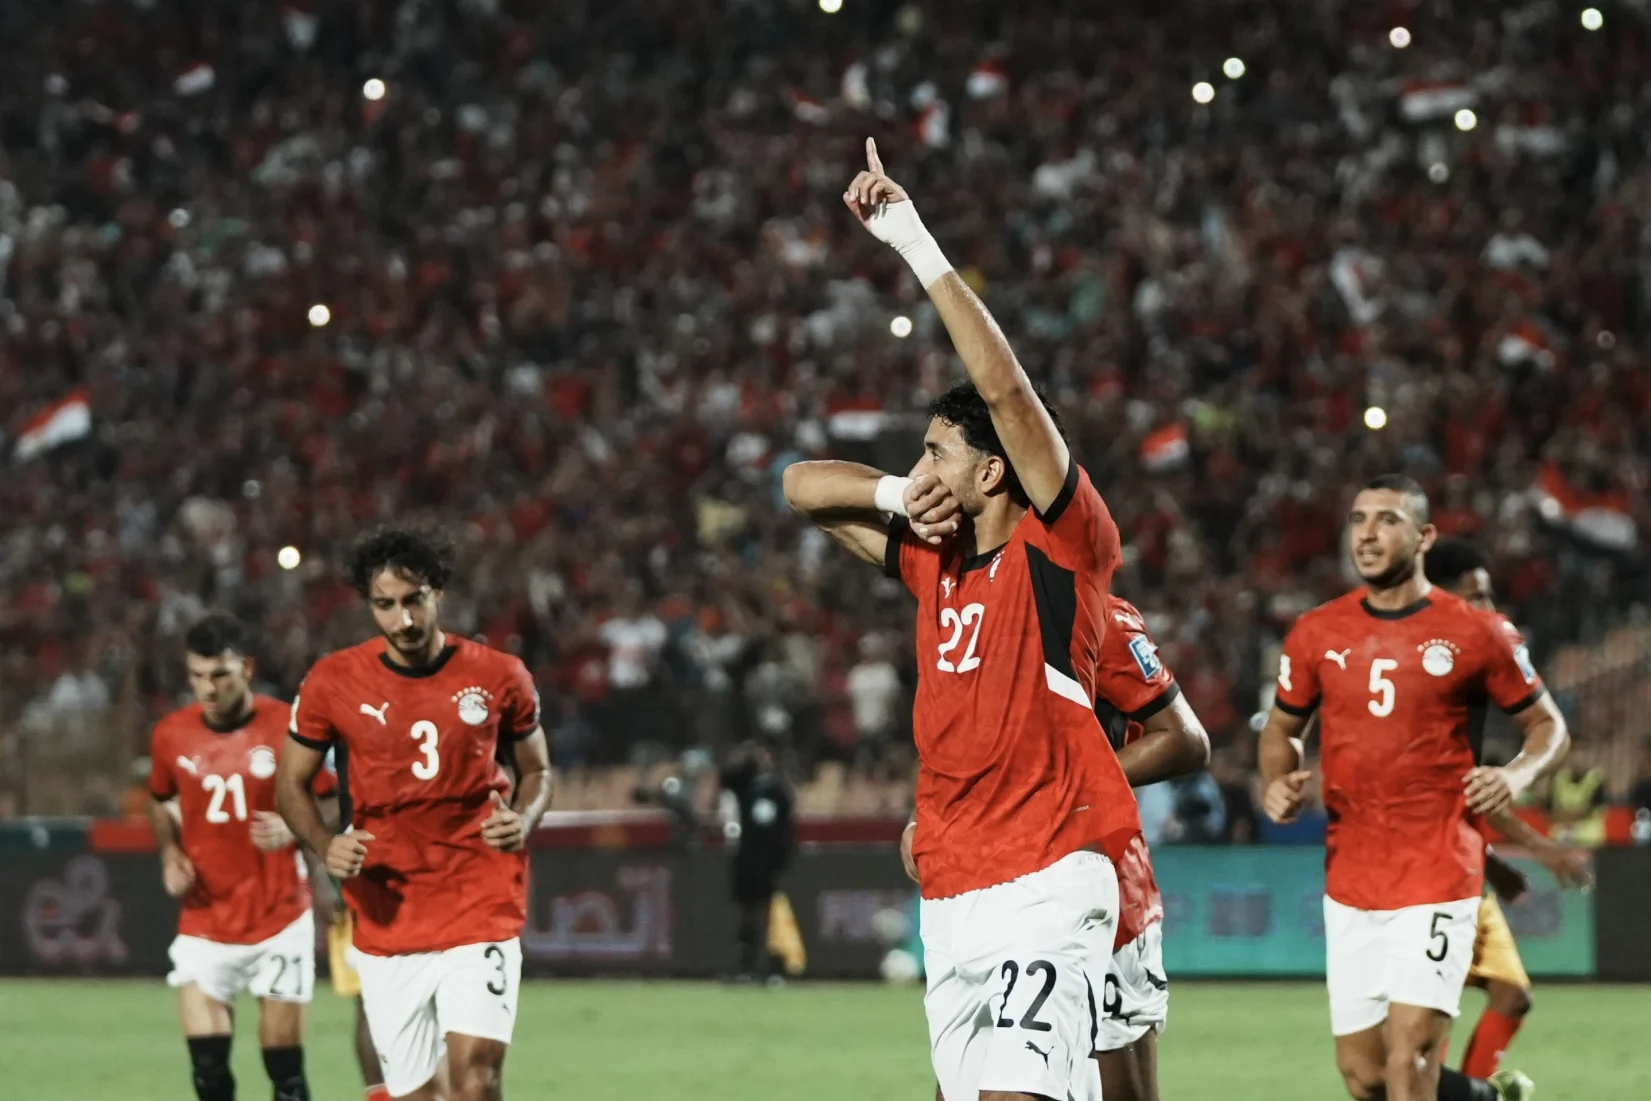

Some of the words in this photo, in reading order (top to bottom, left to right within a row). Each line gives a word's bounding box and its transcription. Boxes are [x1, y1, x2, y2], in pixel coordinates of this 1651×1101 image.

[937, 602, 985, 673] 22
[1368, 658, 1398, 717] 5
[410, 719, 440, 780] 3
[202, 773, 248, 823] 21
[1426, 911, 1453, 962] 5
[270, 954, 302, 996] 21
[484, 945, 505, 996] 3
[997, 960, 1057, 1032] 22
